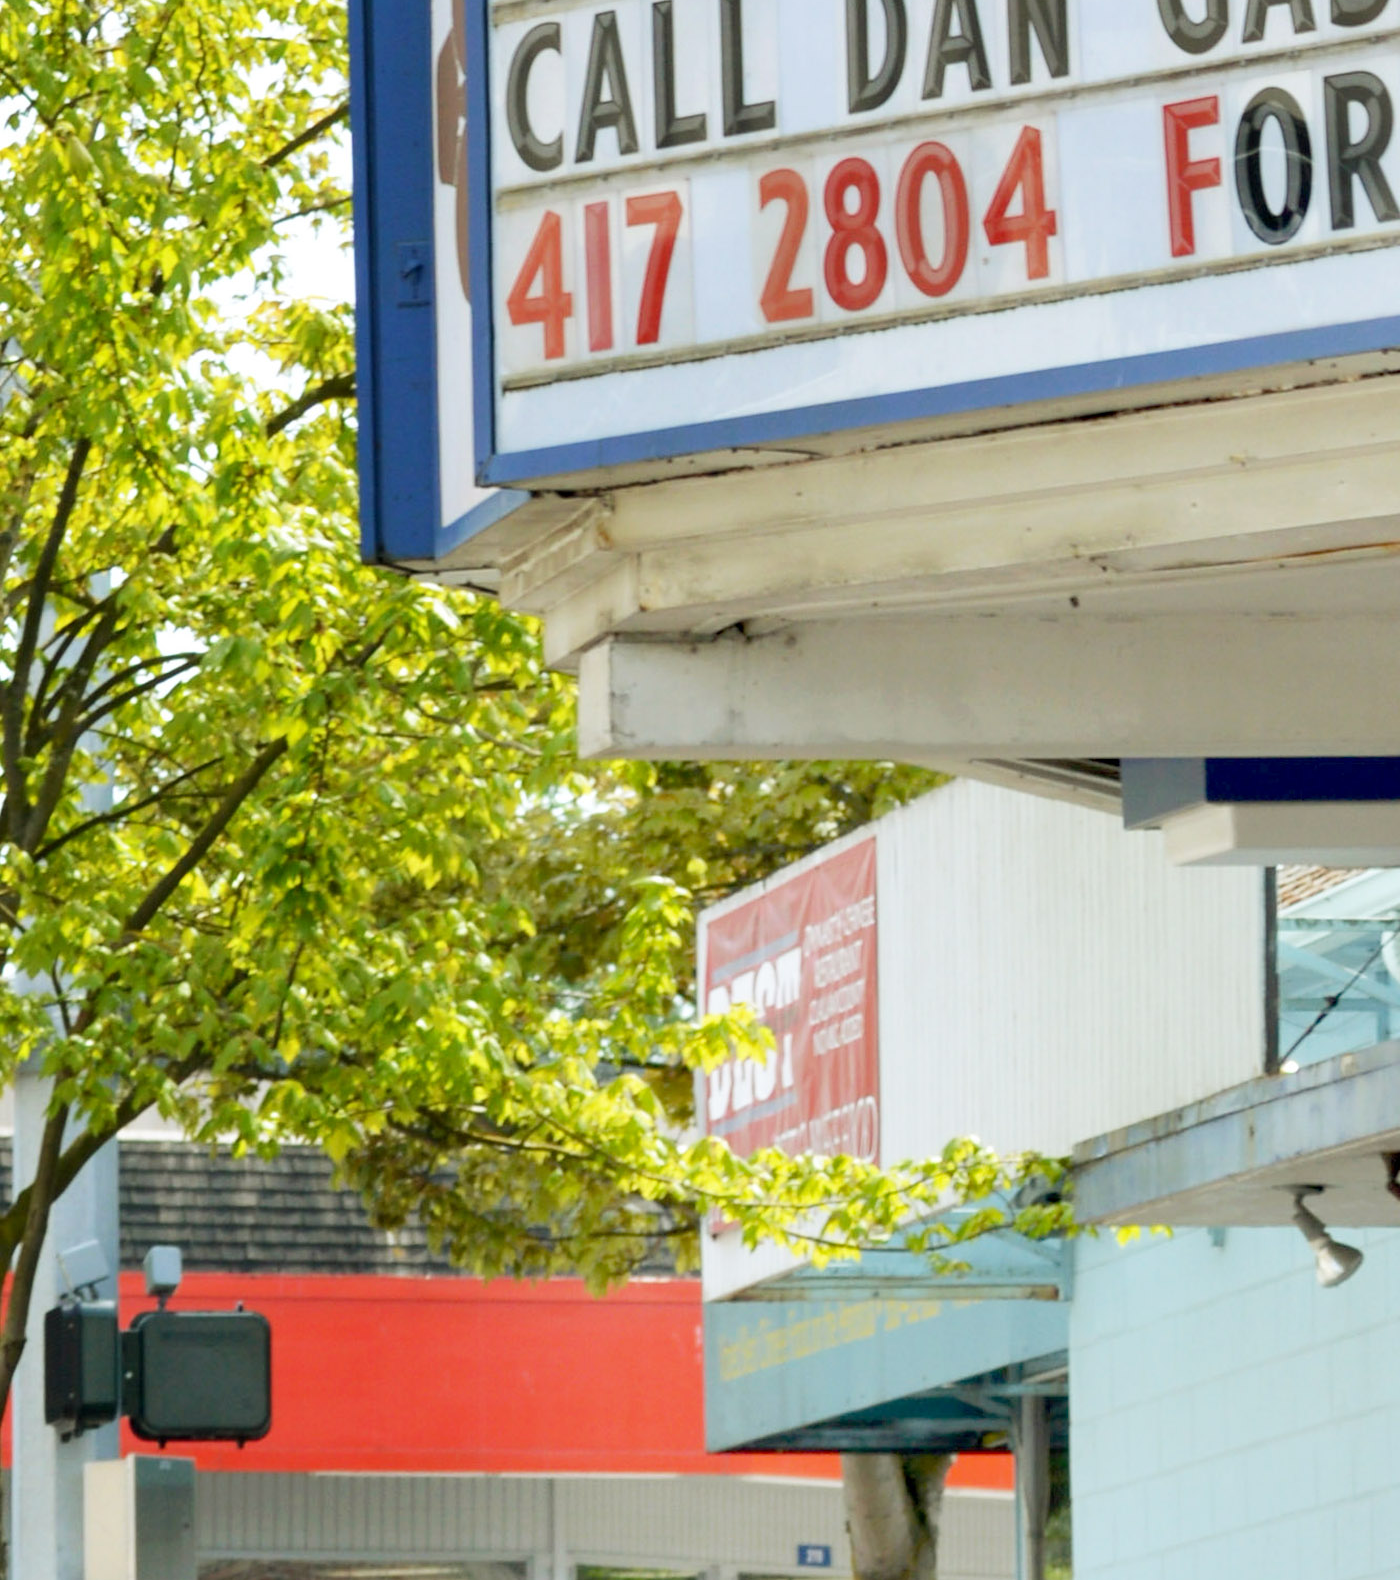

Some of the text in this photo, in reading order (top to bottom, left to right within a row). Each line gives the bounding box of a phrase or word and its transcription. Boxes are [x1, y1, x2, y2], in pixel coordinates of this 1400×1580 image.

[506, 190, 684, 360] 417
[758, 125, 1058, 323] 2804
[1161, 70, 1400, 258] FOR
